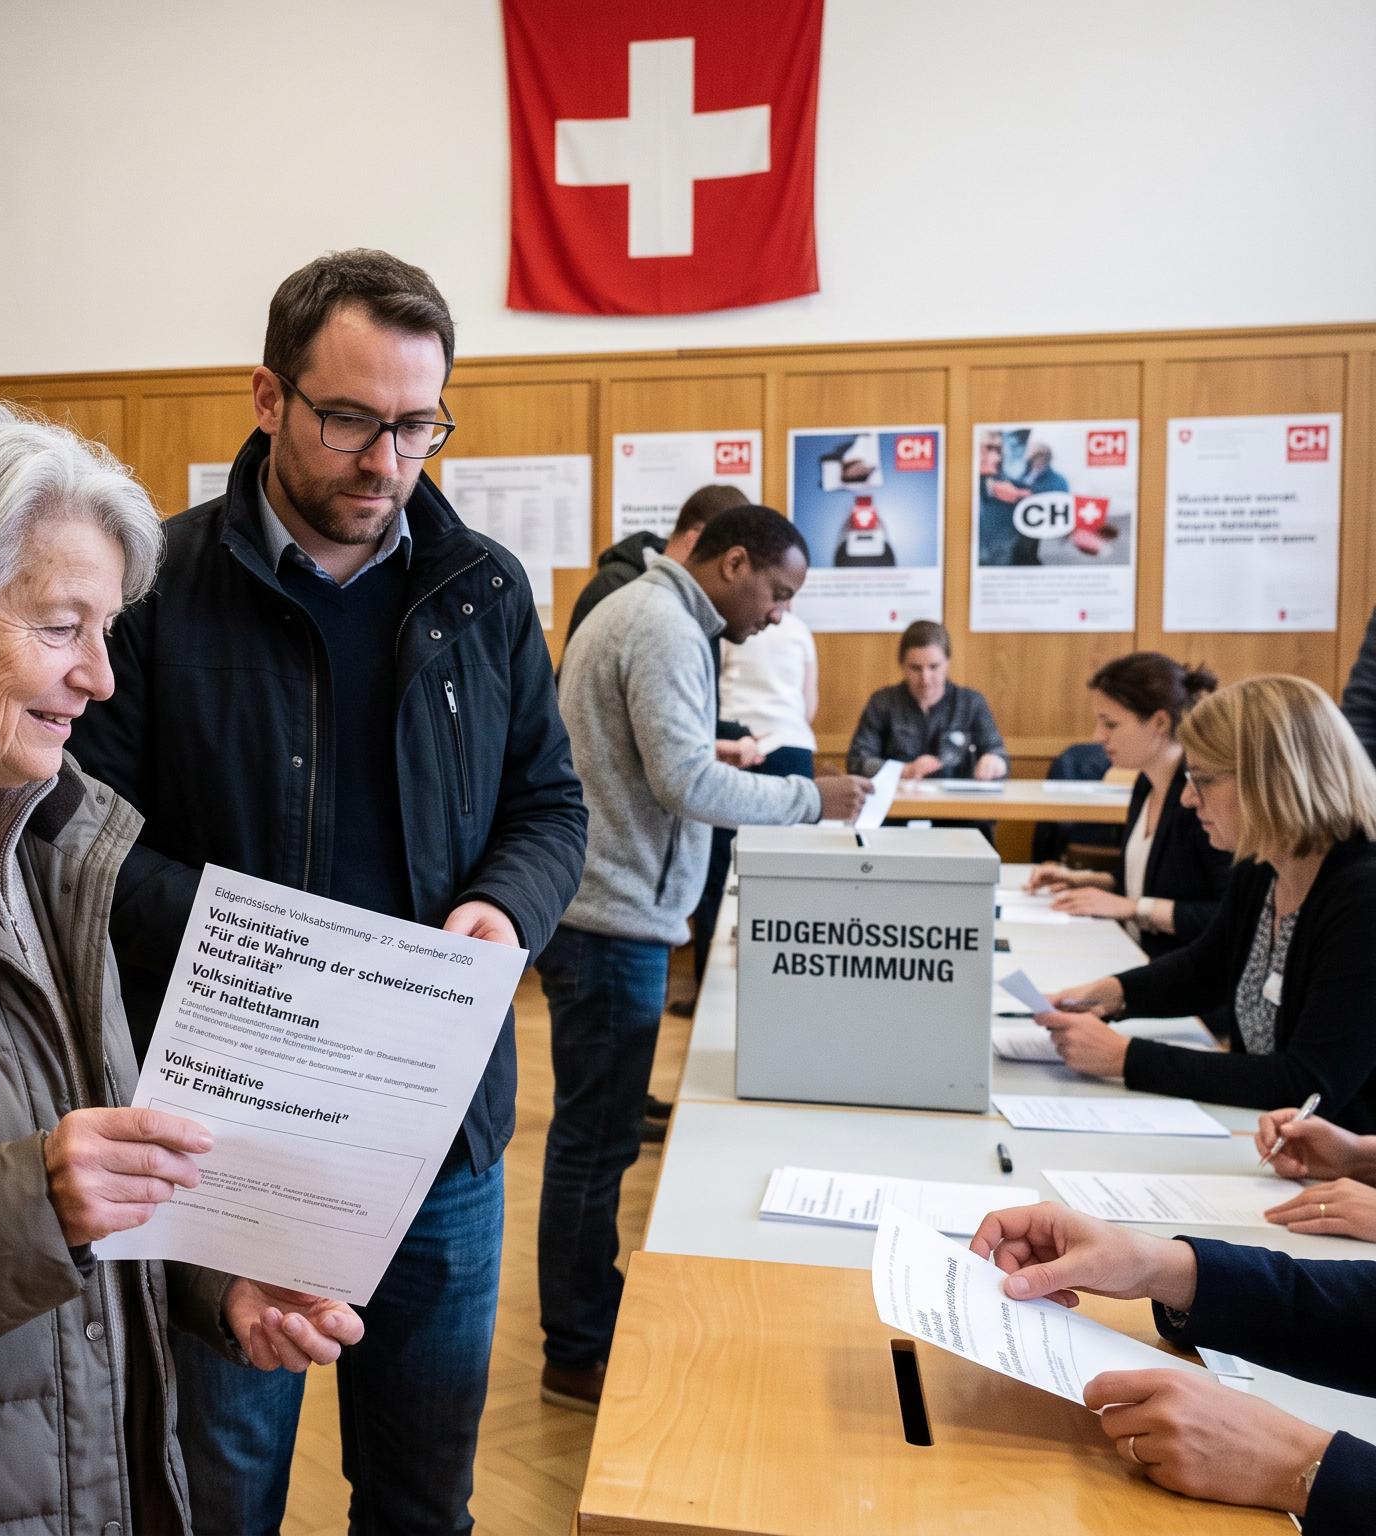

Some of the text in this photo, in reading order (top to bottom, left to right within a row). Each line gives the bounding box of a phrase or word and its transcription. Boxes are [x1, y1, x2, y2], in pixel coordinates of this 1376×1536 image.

[717, 444, 749, 465] CH
[897, 439, 932, 460] CH
[1088, 434, 1124, 455] CH
[1288, 430, 1326, 451] CH
[1022, 503, 1070, 527] CH
[209, 906, 310, 946] Volksinitiative
[751, 918, 979, 951] EIDGENÖSSISCHE
[198, 941, 283, 975] Neutralität”
[204, 924, 474, 1006] “Für die Wahrung der schweizerischen
[380, 935, 395, 947] 27.
[397, 939, 449, 960] September
[449, 952, 474, 966] 2020
[192, 962, 293, 1003] Volksinitiative
[772, 952, 954, 983] ABSTIMMUNG
[187, 980, 217, 999] “Für
[165, 1049, 264, 1090] Volksinitiative
[160, 1068, 349, 1124] “Für Ernährungssicherheit”
